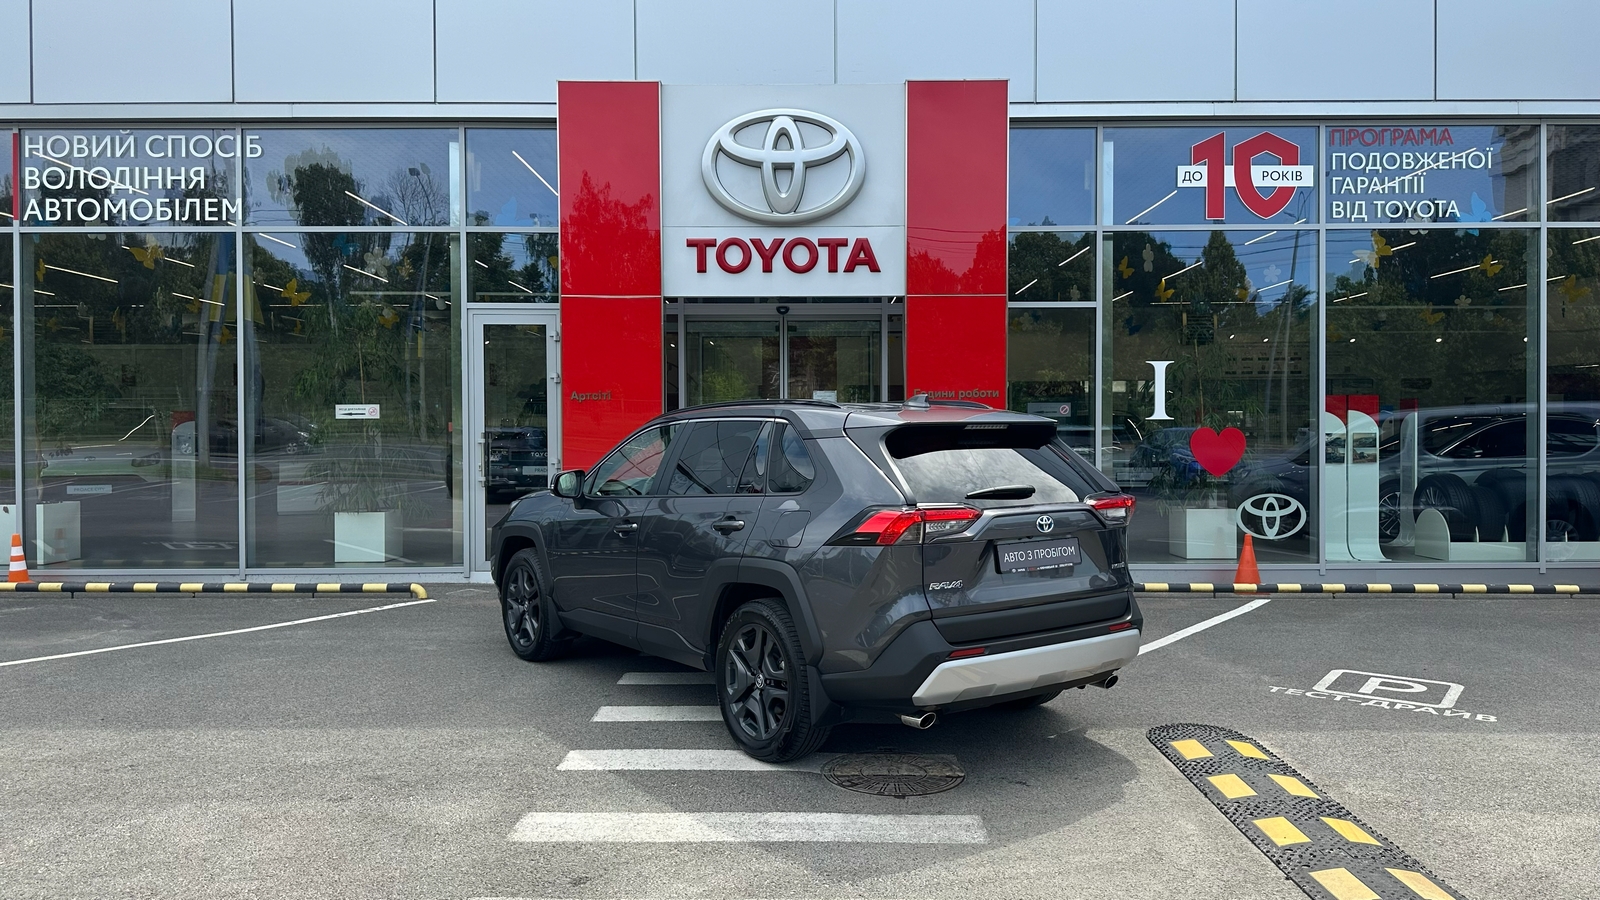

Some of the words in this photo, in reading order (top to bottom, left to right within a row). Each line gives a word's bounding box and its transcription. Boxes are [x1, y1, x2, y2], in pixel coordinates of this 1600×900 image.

[24, 129, 135, 158] НОВИЙ
[145, 134, 263, 158] СПОСІБ
[1331, 128, 1454, 146] ПРОГРАМА
[1331, 147, 1494, 174] ПОДОВЖЕНОЇ
[24, 166, 206, 194] ВОЛОДІННЯ
[1181, 171, 1203, 184] ДО
[1191, 131, 1301, 220] 10
[1261, 170, 1303, 182] РОКІВ
[1331, 172, 1426, 195] ГАРАНТІЇ
[23, 198, 243, 222] АВТОМОБІЛЕМ
[1331, 200, 1368, 222] ВІД
[1373, 200, 1461, 218] TOYOTA
[686, 236, 882, 274] TOYOTA
[570, 390, 611, 402] Артсіті
[958, 388, 999, 400] роботи
[1003, 550, 1026, 563] АВТО
[1034, 545, 1076, 560] ПРОБІГОМ
[928, 579, 963, 590] RAV4
[1268, 685, 1498, 722] ТЕСТ-ДРАЙВ
